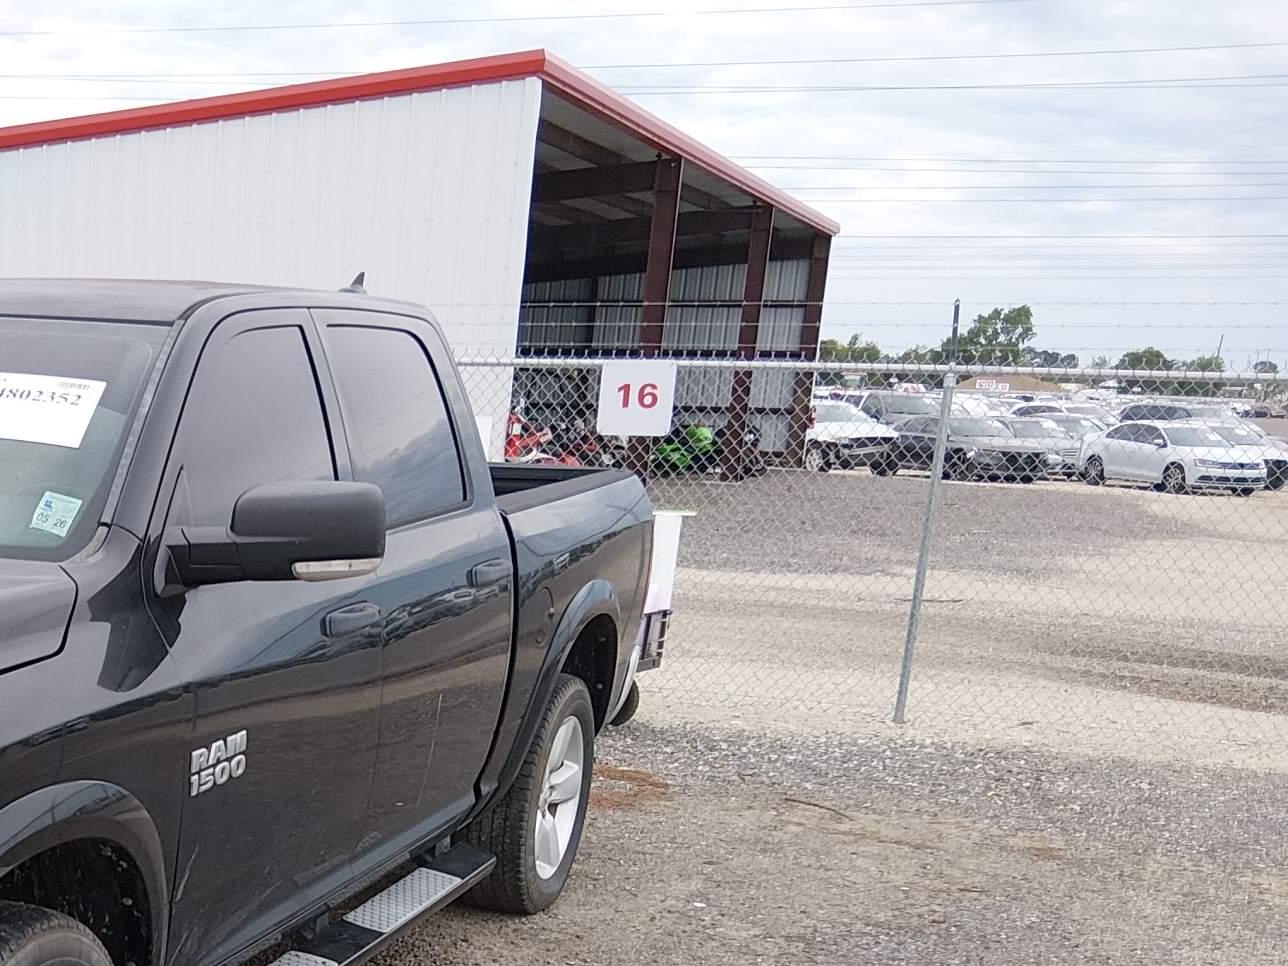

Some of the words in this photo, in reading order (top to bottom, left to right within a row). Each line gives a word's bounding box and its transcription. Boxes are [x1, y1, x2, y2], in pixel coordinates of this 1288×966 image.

[617, 383, 659, 409] 16
[36, 512, 49, 524] 05
[53, 518, 68, 529] 26
[190, 729, 248, 774] RAM
[189, 753, 247, 797] 1500
